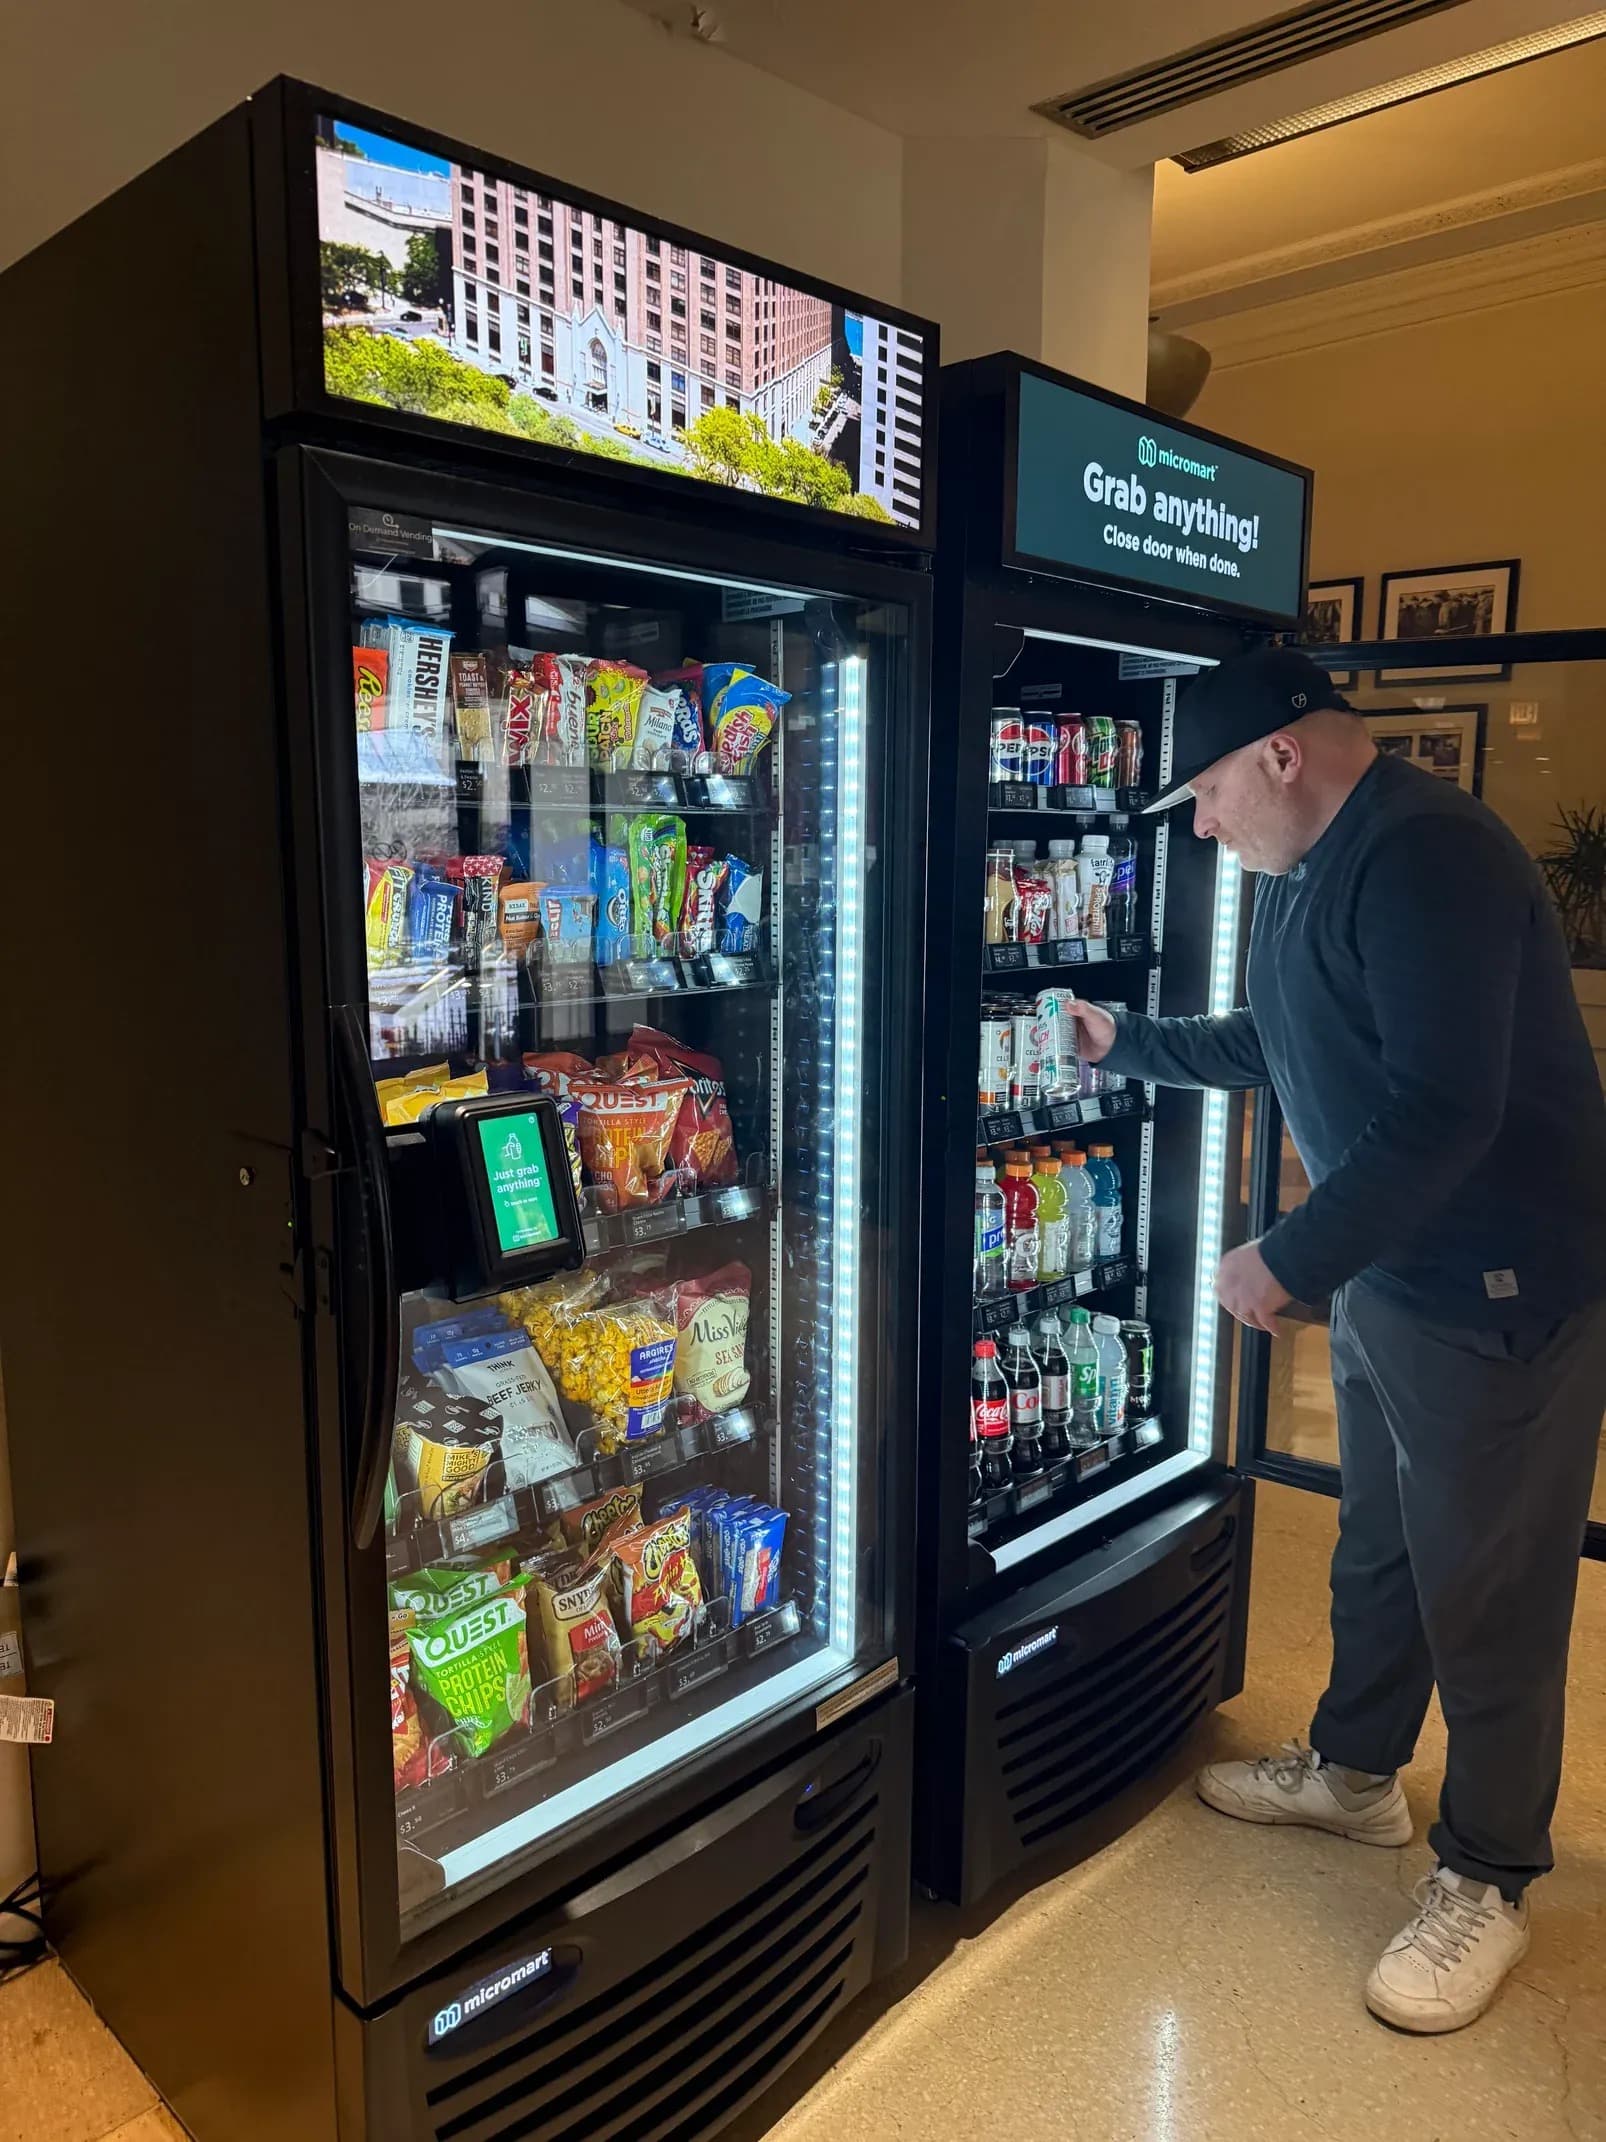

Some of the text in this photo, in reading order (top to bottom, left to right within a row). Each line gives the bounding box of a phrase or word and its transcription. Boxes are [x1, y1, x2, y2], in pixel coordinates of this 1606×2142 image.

[1158, 449, 1217, 482] micromart
[1083, 461, 1260, 553] Grab anything!
[348, 522, 361, 531] On
[363, 524, 398, 537] Demand
[399, 530, 433, 544] Vending
[1103, 524, 1241, 578] Close door when done.
[644, 715, 672, 732] Milano
[481, 876, 493, 912] KIND
[580, 1091, 661, 1109] QUEST
[493, 1163, 539, 1181] Just grab
[496, 1177, 541, 1193] anything
[690, 1319, 729, 1346] Miss
[487, 1360, 516, 1373] THINK
[715, 1349, 733, 1366] SEA
[486, 1387, 513, 1407] BEEF
[515, 1379, 541, 1395] JERKY
[445, 1464, 475, 1473] GOOD
[446, 1449, 479, 1461] MIKE'S
[405, 1575, 489, 1616] QUEST
[425, 1601, 508, 1661] QUEST
[1013, 1627, 1057, 1663] micromart
[435, 1654, 477, 1679] TORTILLA
[438, 1649, 508, 1697] PROTEIN
[445, 1675, 506, 1718] CHIPS
[463, 1950, 550, 2014] micromart
